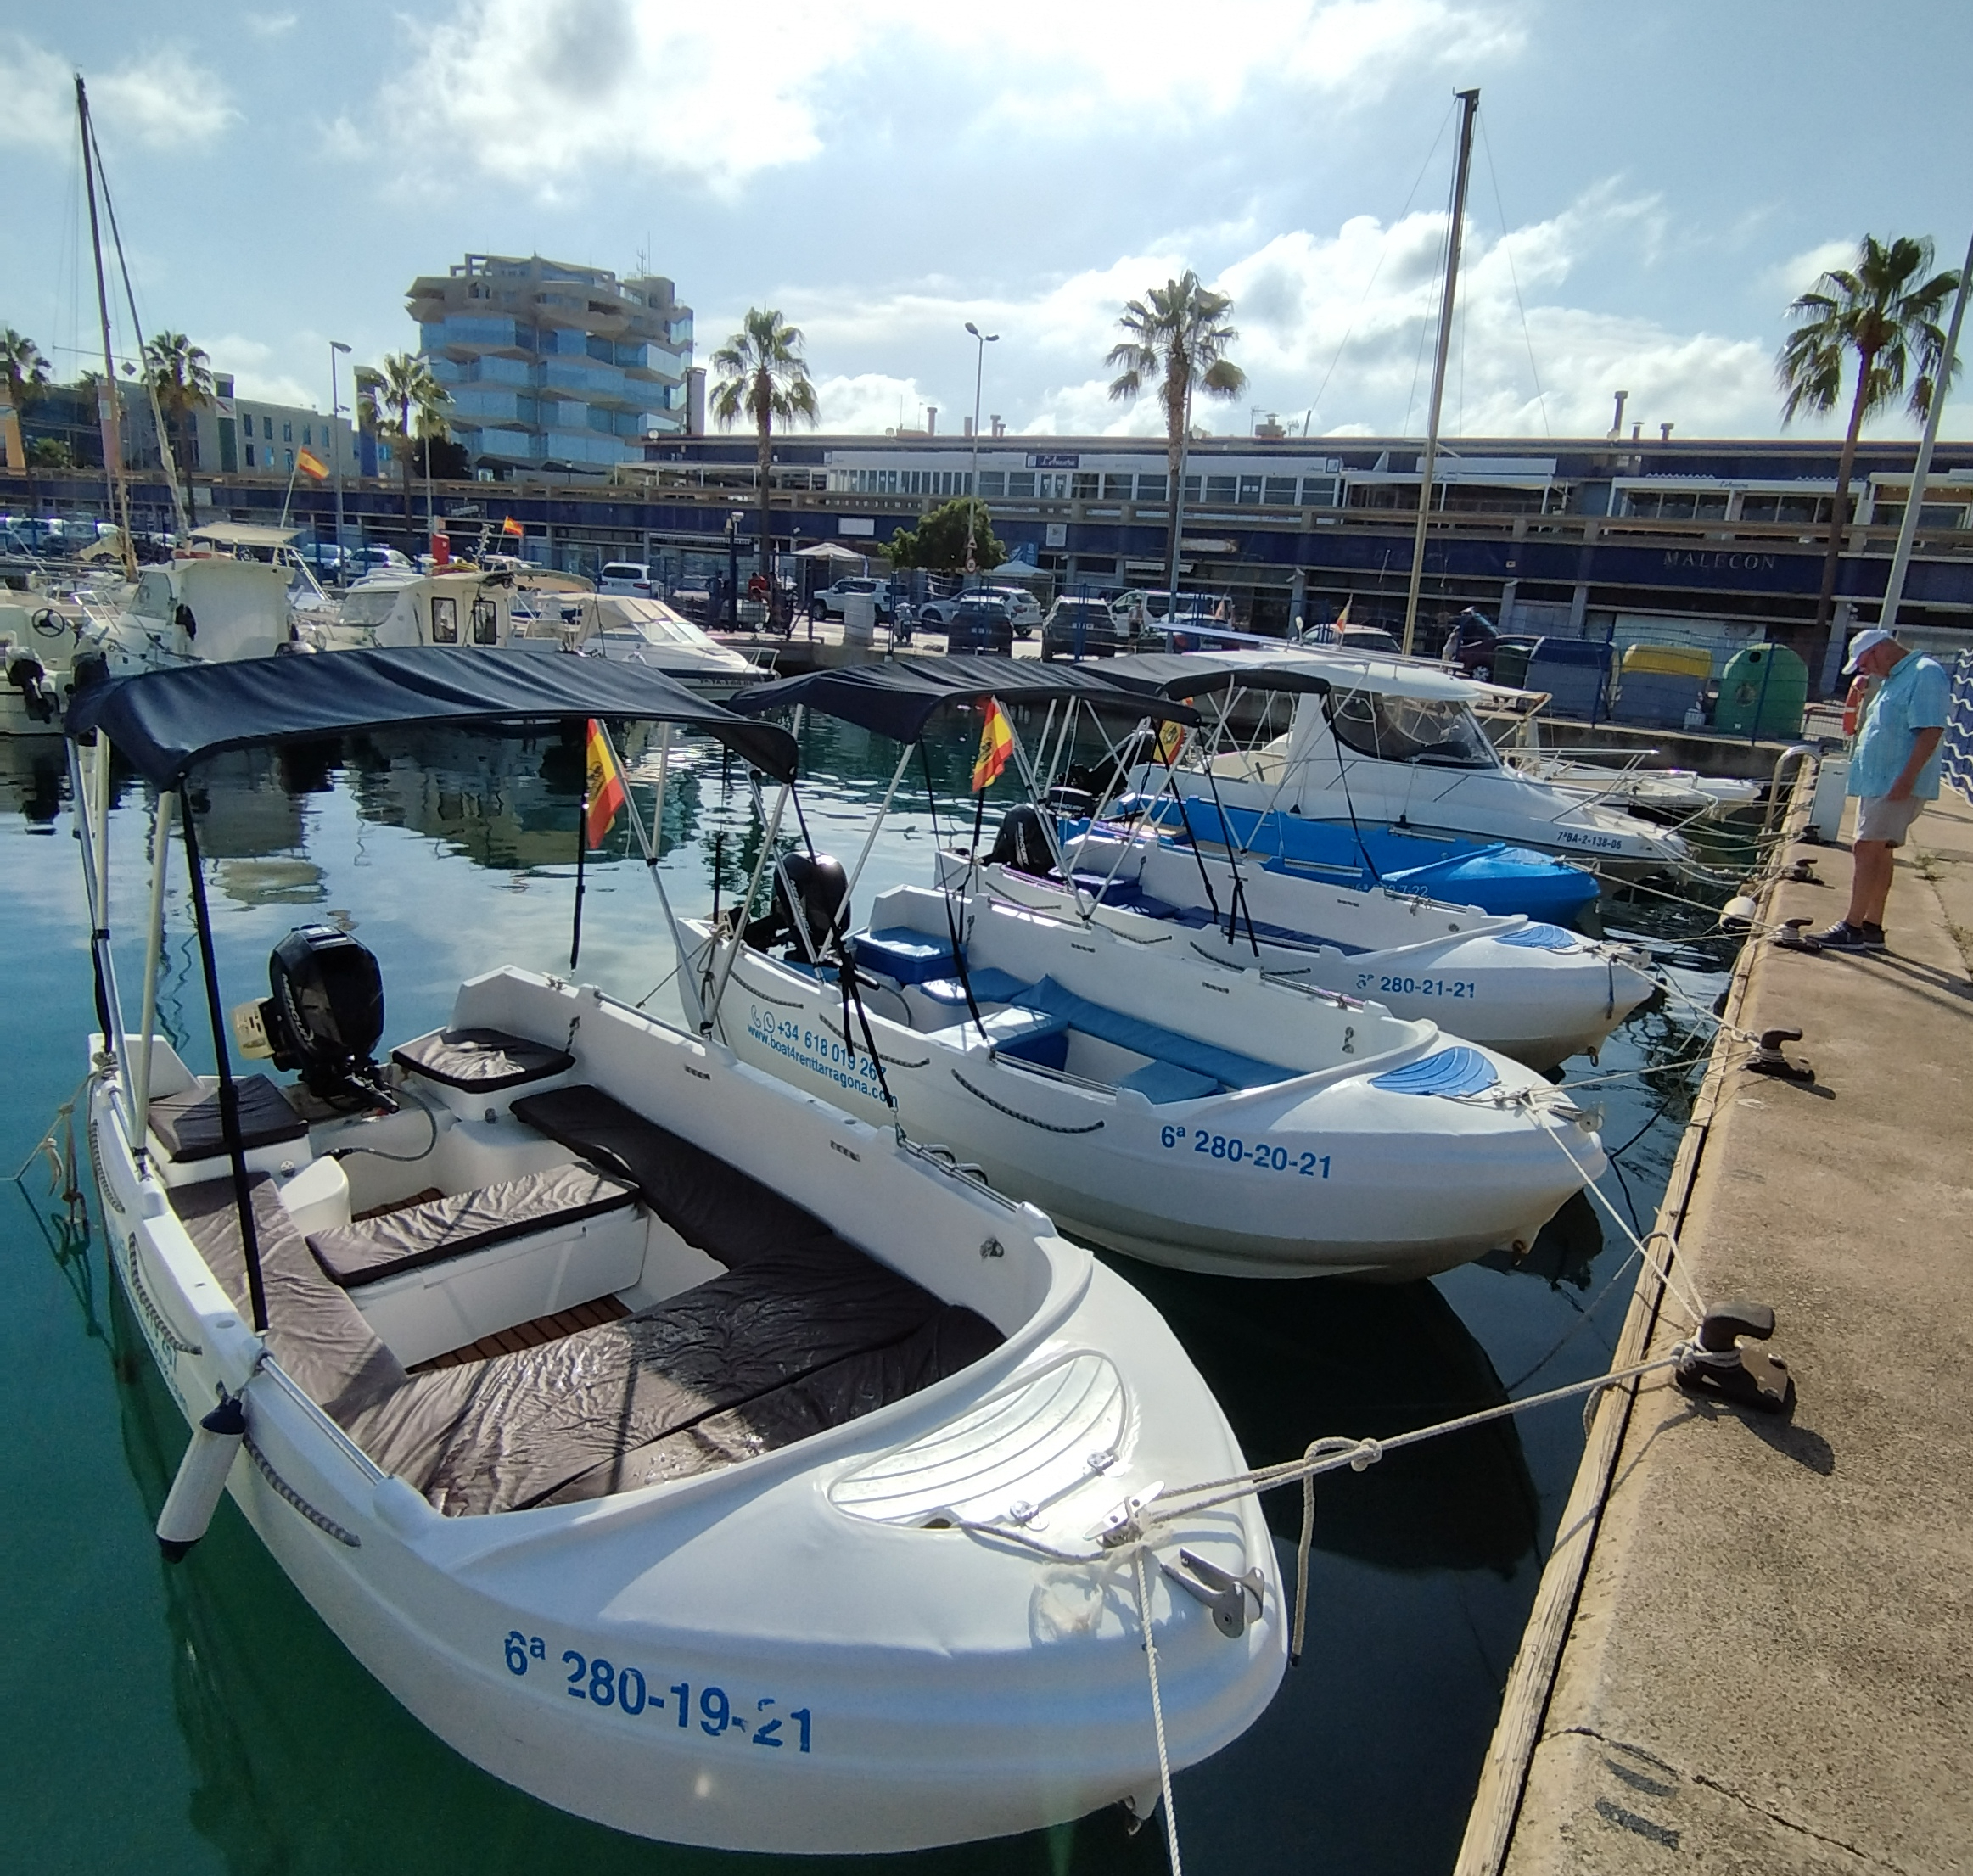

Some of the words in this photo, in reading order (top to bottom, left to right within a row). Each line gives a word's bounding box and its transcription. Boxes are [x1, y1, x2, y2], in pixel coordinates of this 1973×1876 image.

[1663, 551, 1776, 571] MALECON
[1380, 976, 1476, 999] 280-21-21
[777, 1020, 799, 1041] +34
[804, 1030, 828, 1057] 618
[1161, 1125, 1185, 1148] 6ª
[1194, 1129, 1331, 1179] 280-20-21
[504, 1630, 546, 1677] 6ª
[561, 1649, 810, 1754] 280-19-21
